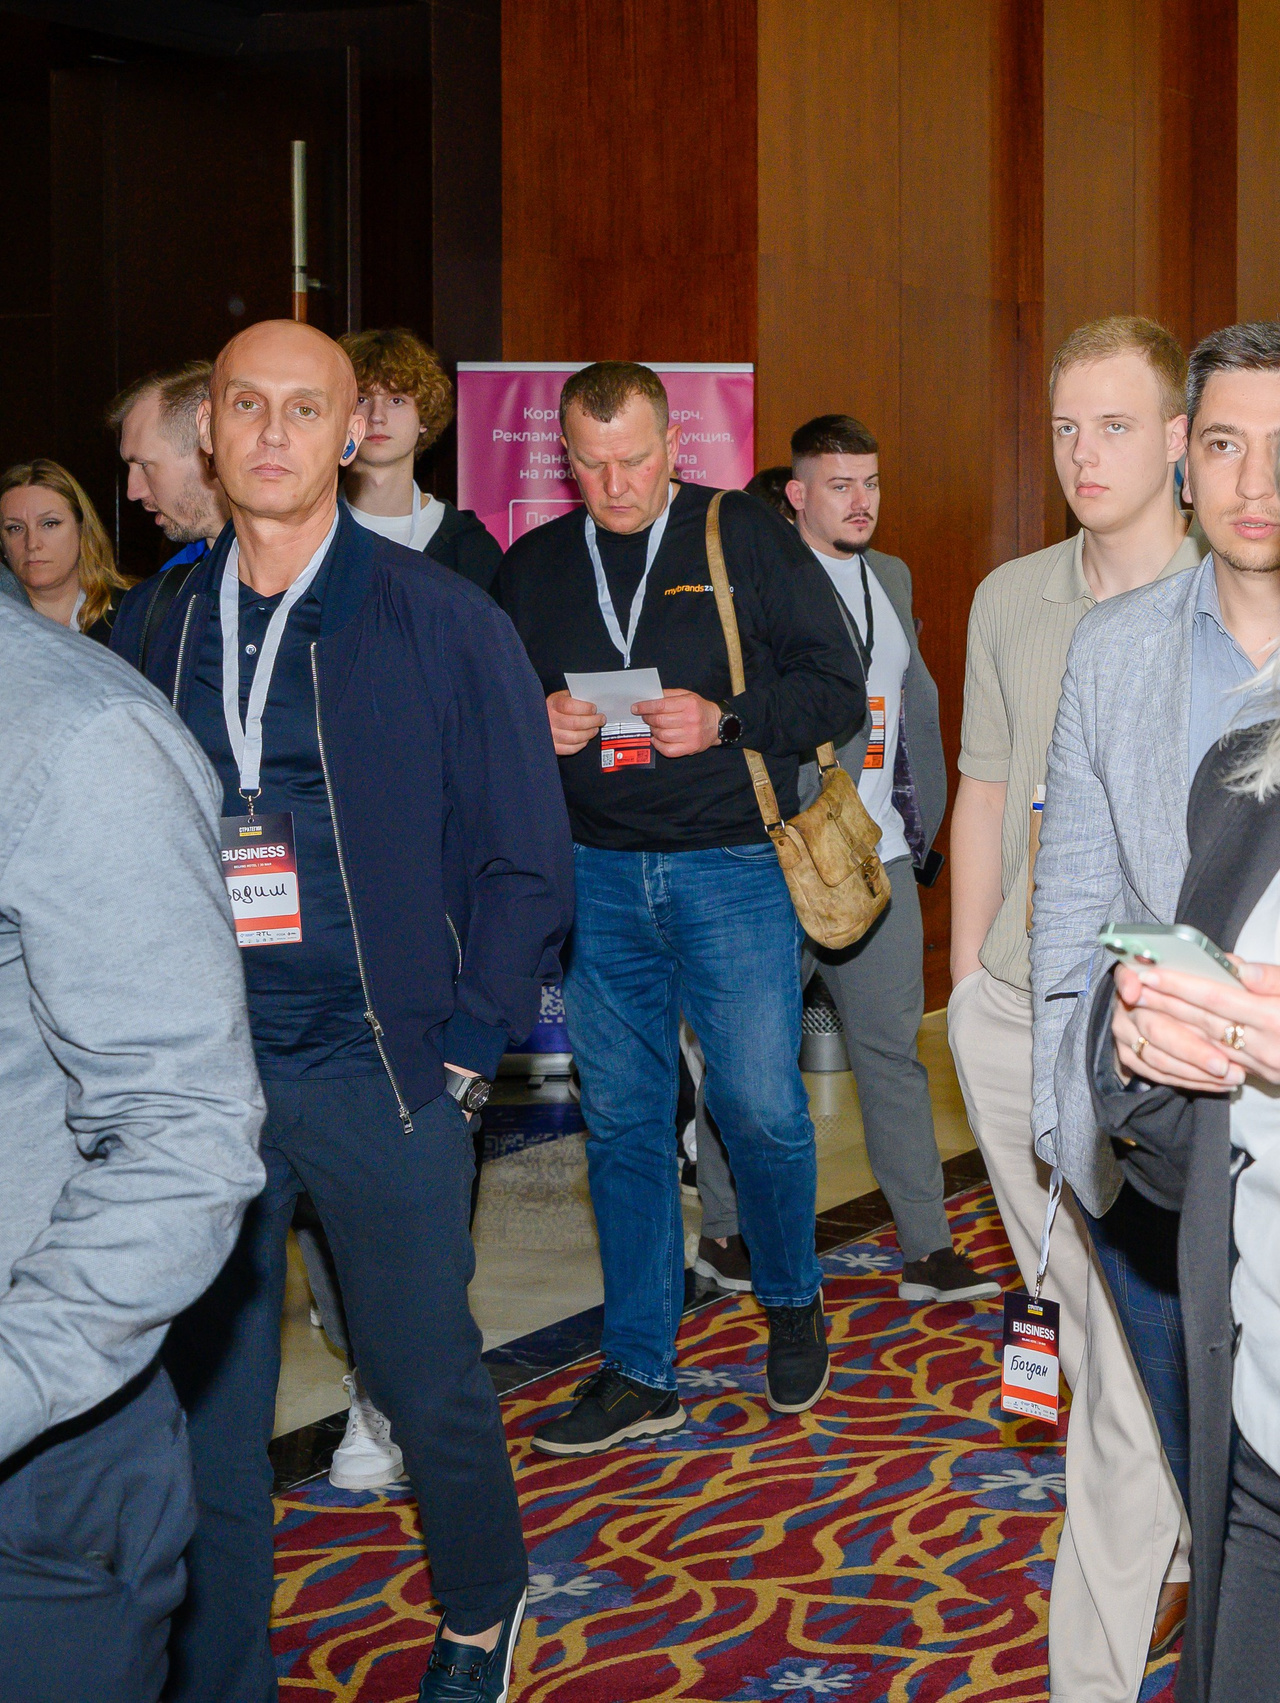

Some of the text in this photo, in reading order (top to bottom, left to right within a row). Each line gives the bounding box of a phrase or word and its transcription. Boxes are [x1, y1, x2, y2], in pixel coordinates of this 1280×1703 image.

[670, 410, 704, 423] ерч.
[492, 429, 563, 442] Рекламн
[529, 452, 698, 465] Нане па
[519, 469, 539, 479] на
[679, 469, 707, 480] сти
[221, 845, 286, 862] BUSINESS
[1012, 1321, 1055, 1341] BUSINESS
[1010, 1355, 1049, 1381] Богдан
